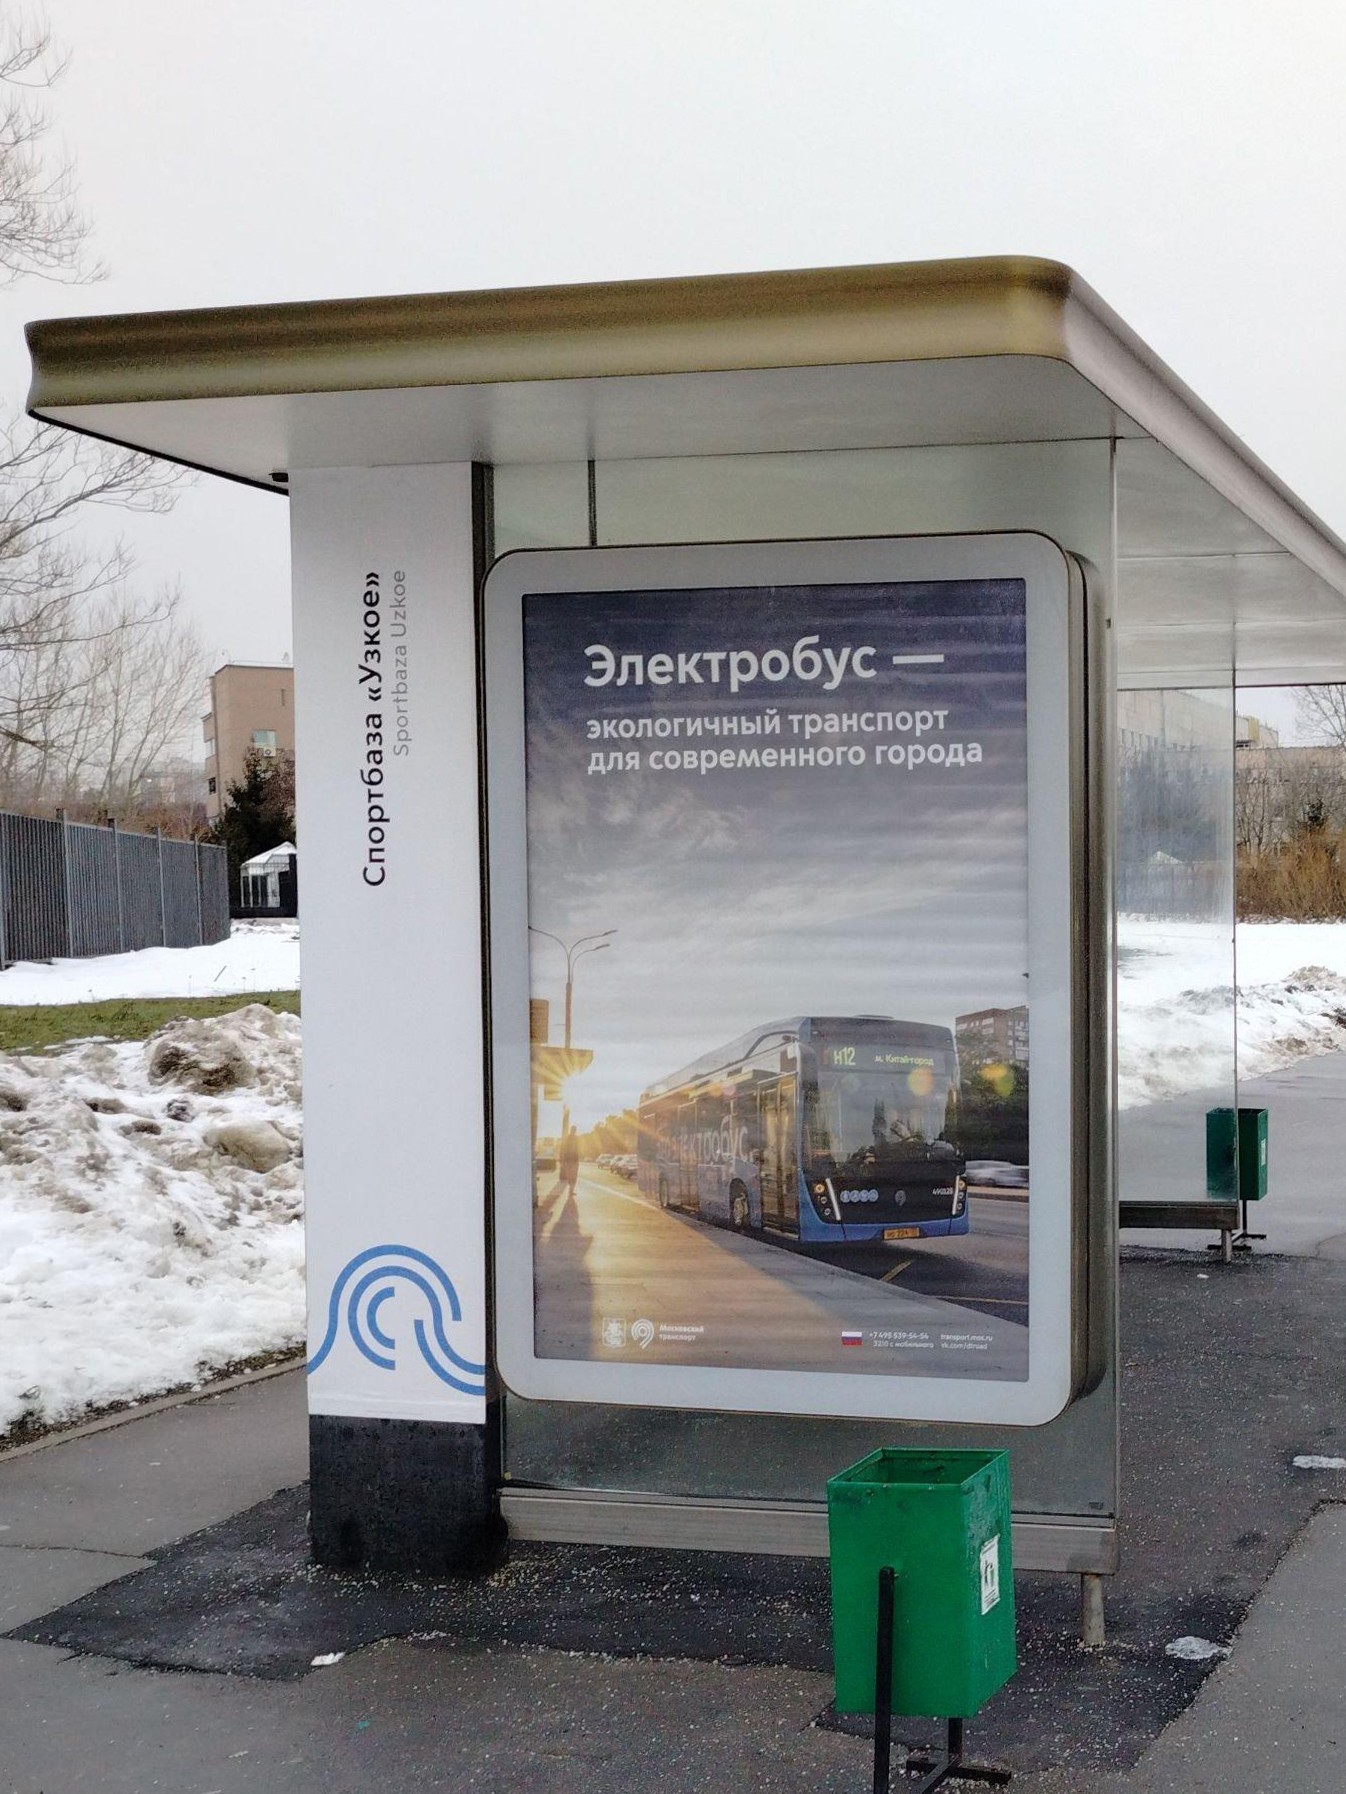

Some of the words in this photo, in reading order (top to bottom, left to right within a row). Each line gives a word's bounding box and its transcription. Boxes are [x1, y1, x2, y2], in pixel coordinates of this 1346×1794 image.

[358, 571, 383, 702] «Узкое»
[389, 570, 407, 637] Uzkoe
[583, 635, 877, 692] Электробус
[391, 645, 413, 756] Sportbaza
[586, 709, 781, 739] экологичный
[787, 709, 949, 740] транспорт
[587, 748, 641, 774] для
[648, 746, 866, 774] современного
[875, 742, 983, 770] города
[360, 712, 390, 886] Спортбаза
